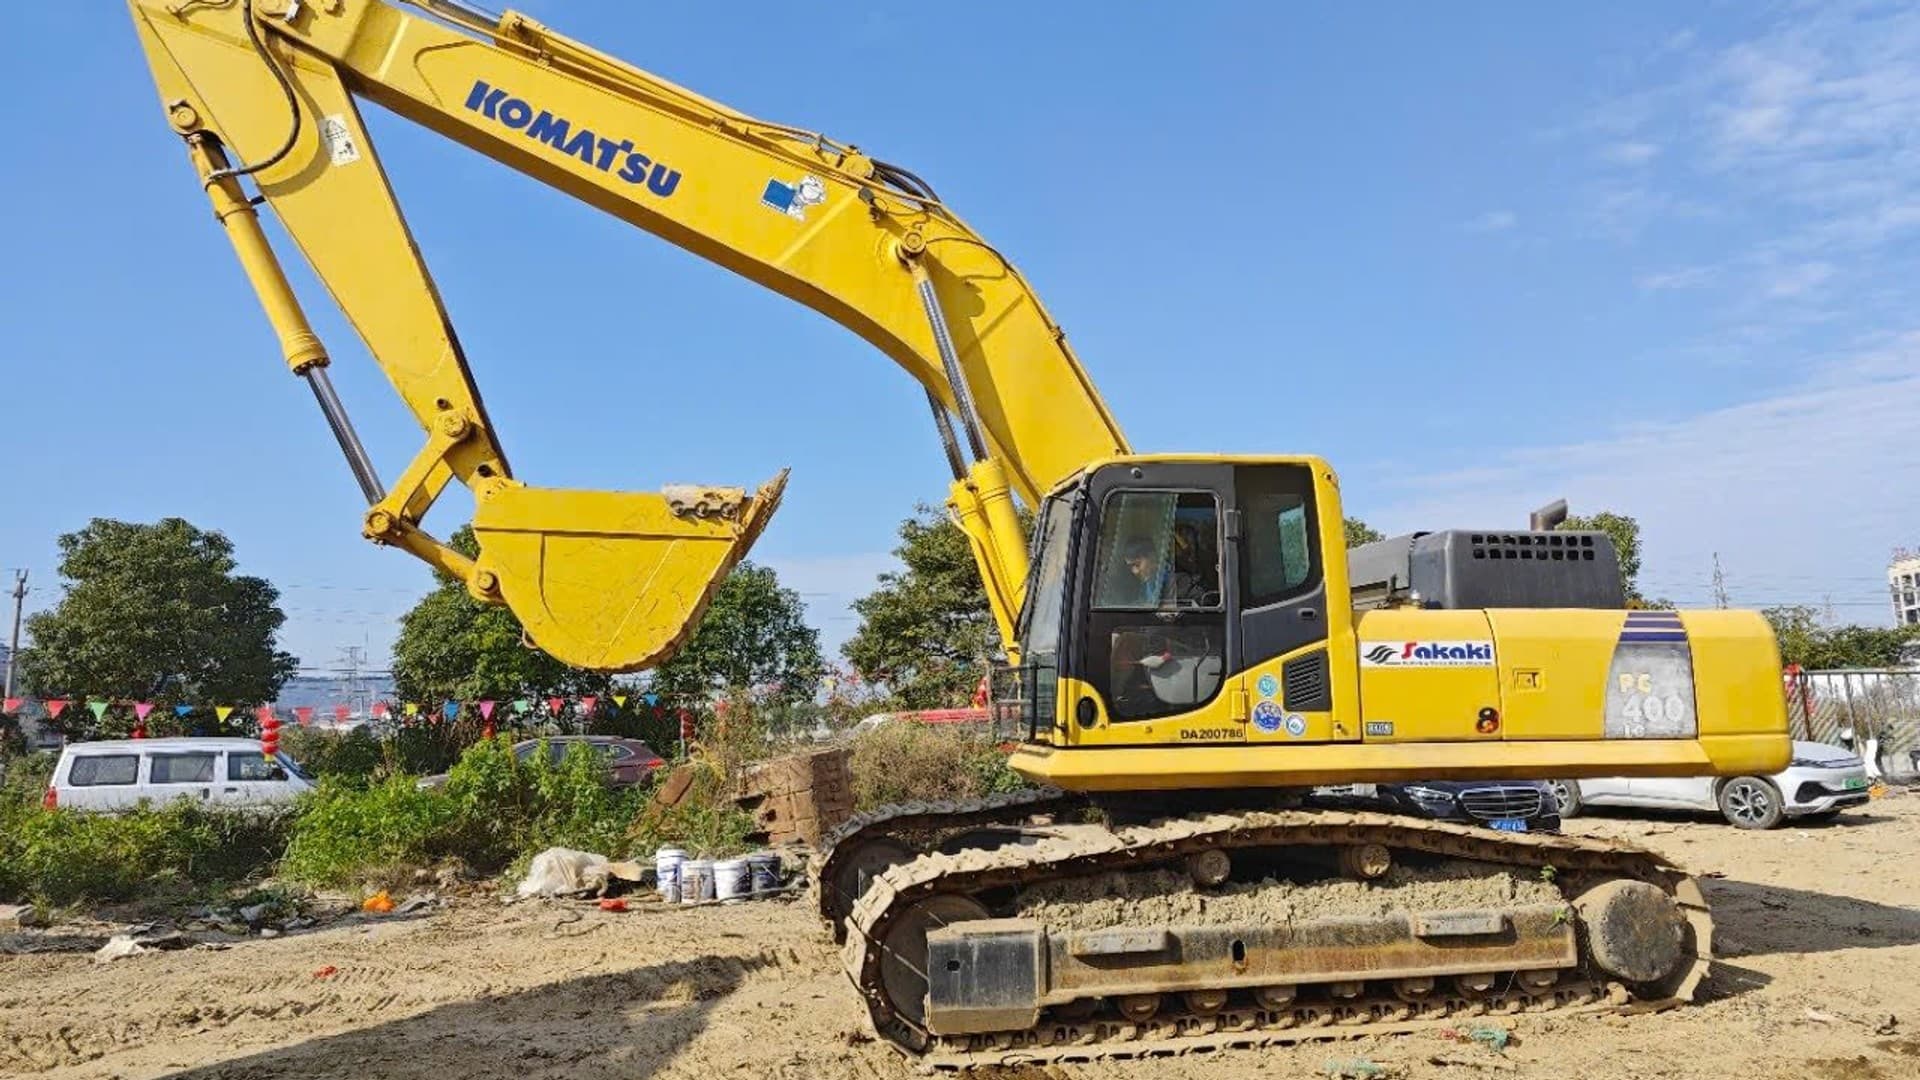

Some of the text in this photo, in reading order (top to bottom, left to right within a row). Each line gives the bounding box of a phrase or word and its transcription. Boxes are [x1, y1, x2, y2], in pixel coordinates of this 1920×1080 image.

[465, 80, 682, 198] KOMATSU
[1401, 641, 1491, 660] Sakaki
[1476, 707, 1500, 734] 8
[1622, 695, 1684, 722] 400
